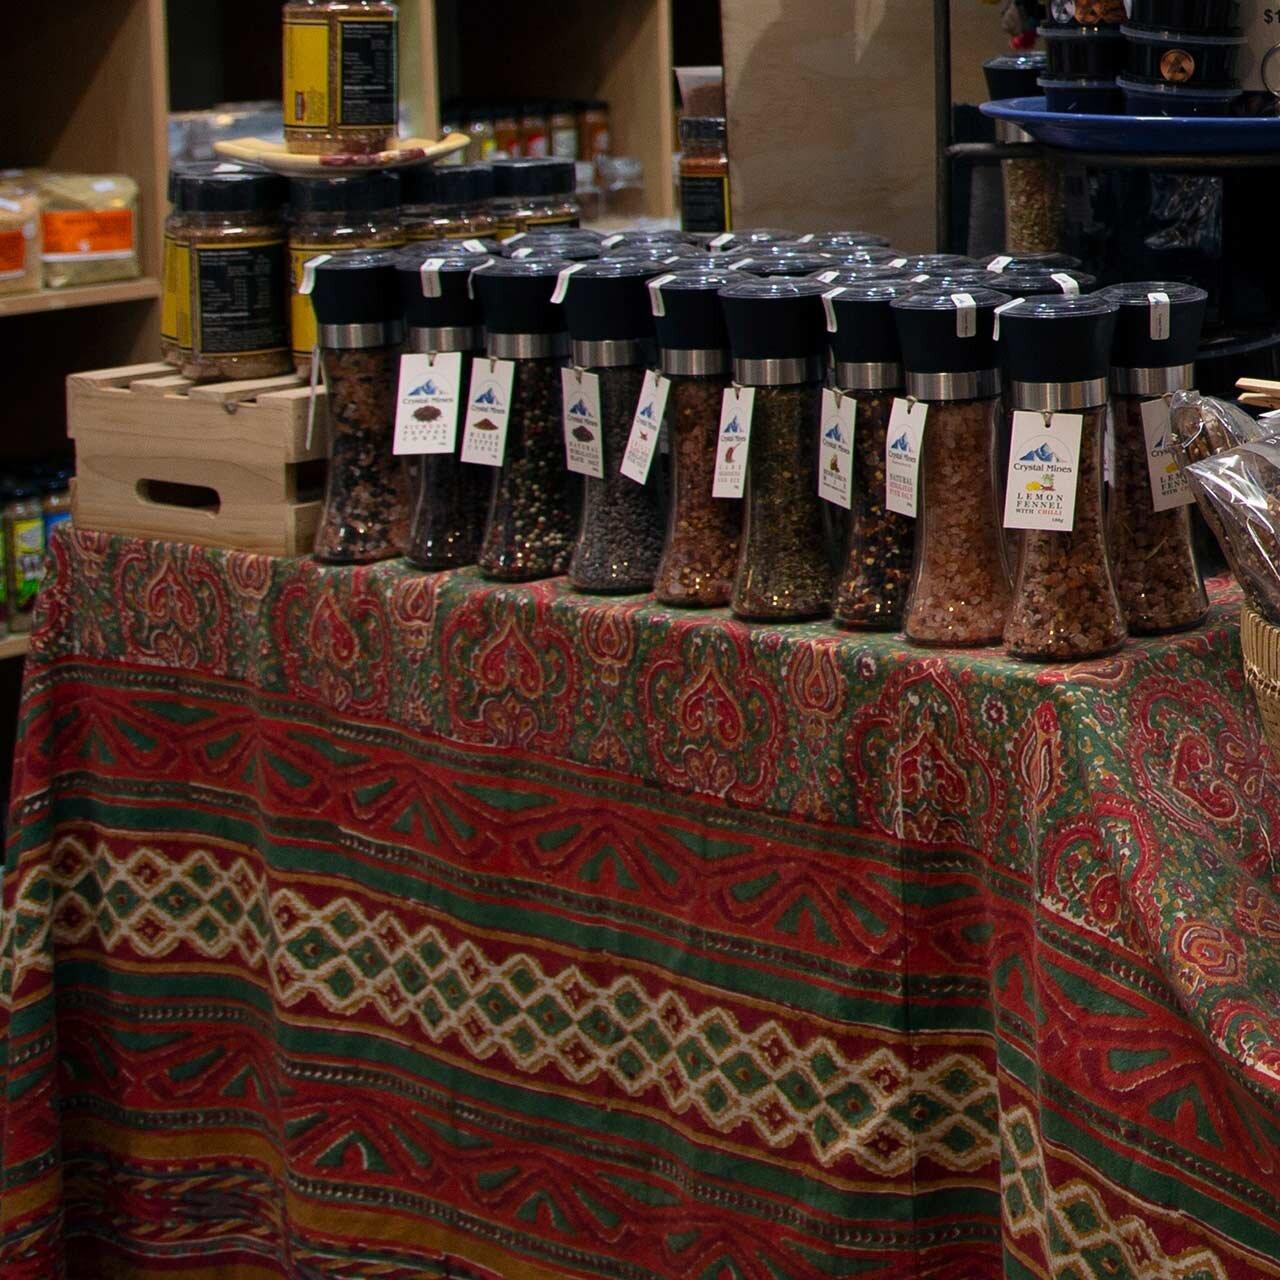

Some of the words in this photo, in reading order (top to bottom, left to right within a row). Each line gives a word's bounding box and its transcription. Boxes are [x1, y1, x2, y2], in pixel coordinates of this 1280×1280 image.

[1013, 463, 1044, 472] Crystal
[1046, 464, 1073, 473] Mines
[1016, 493, 1064, 501] LEMON
[1016, 500, 1063, 510] FENNEL
